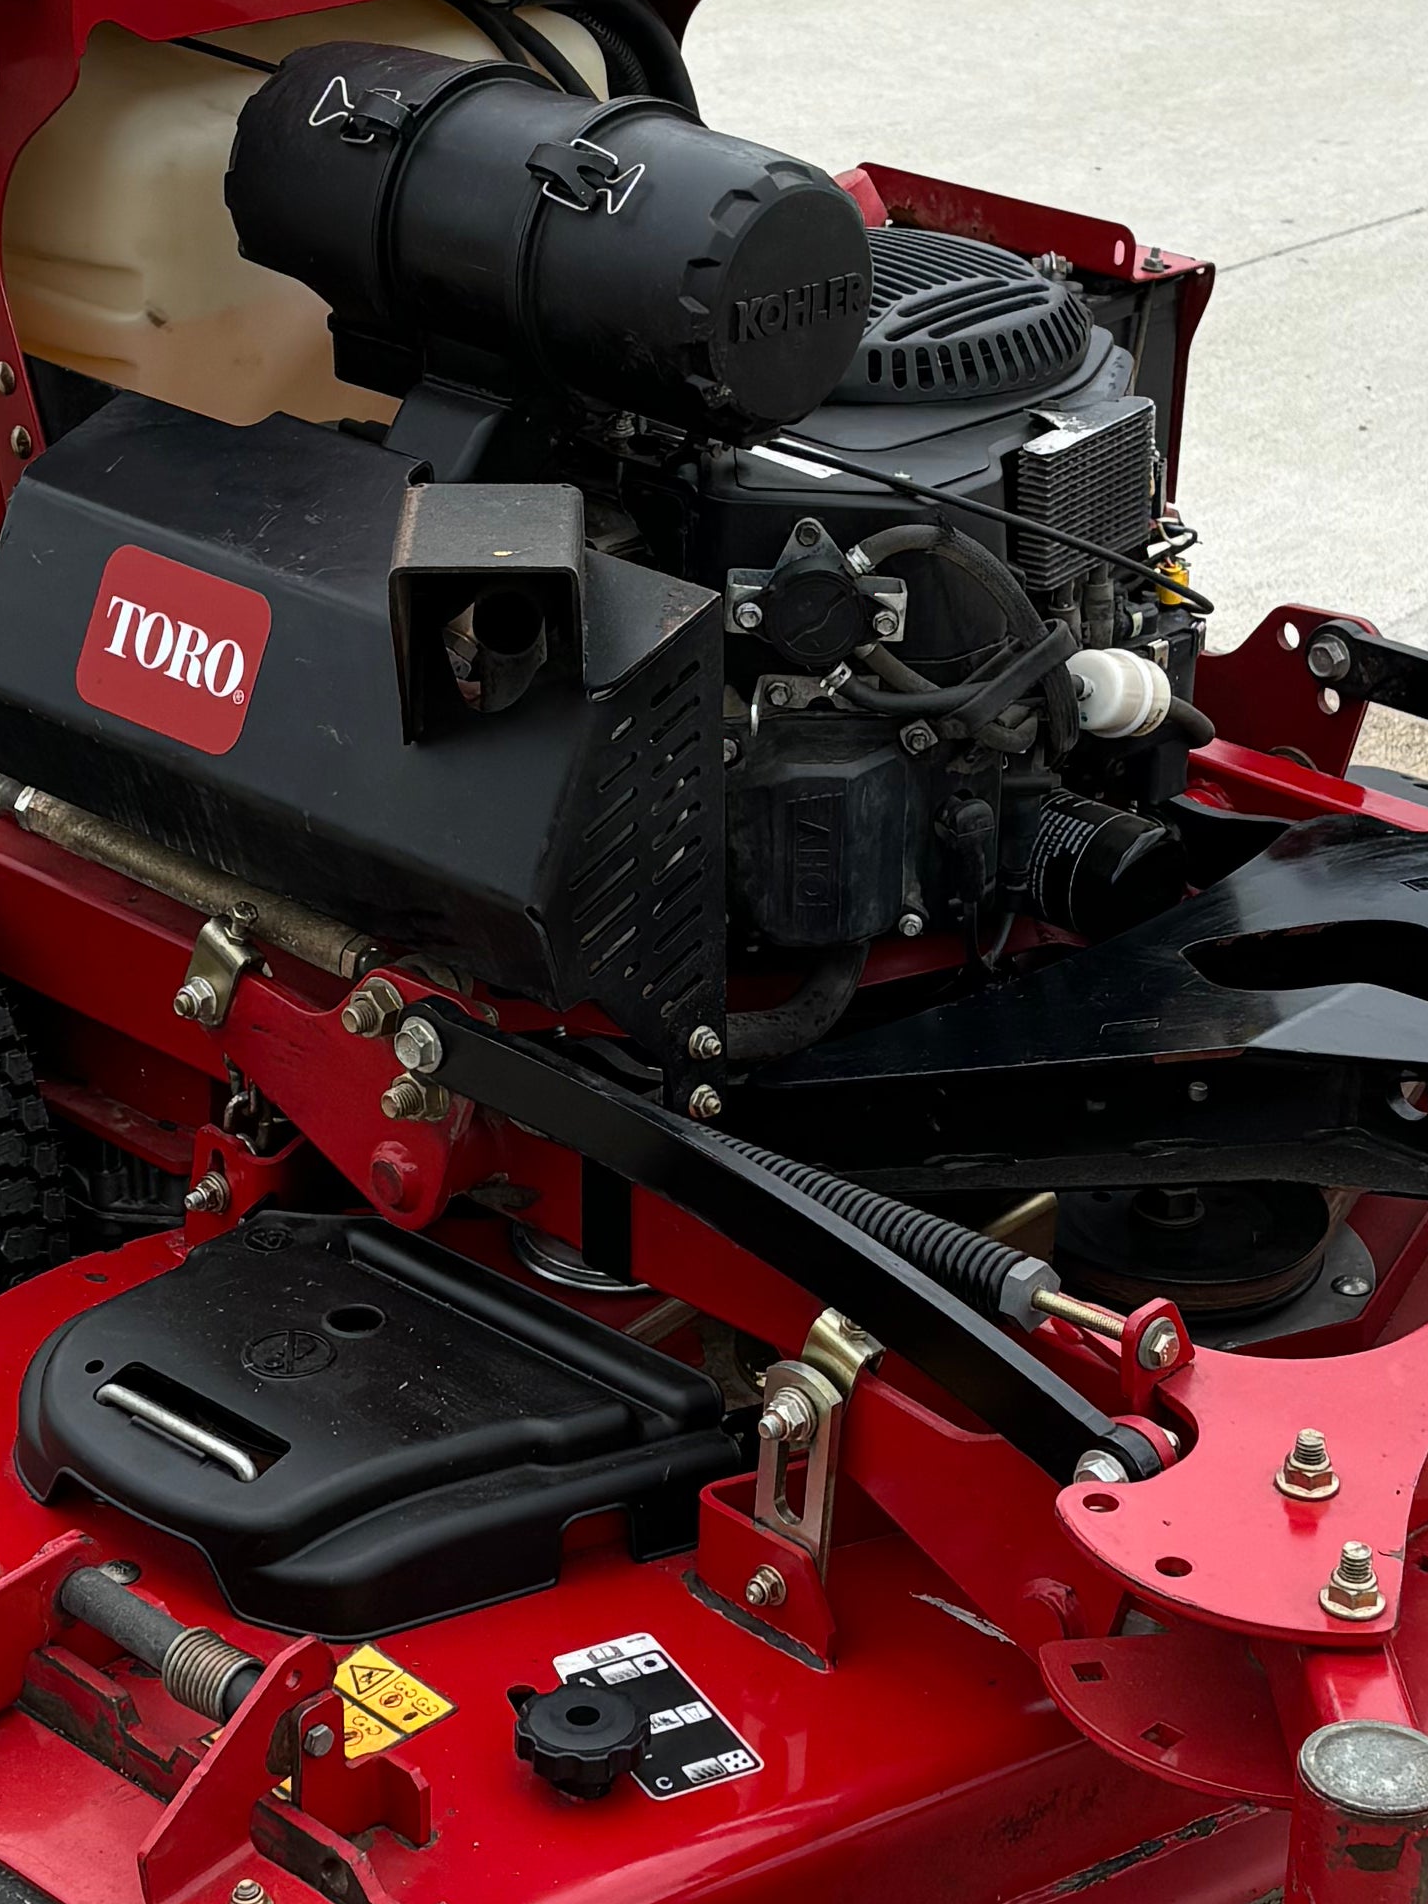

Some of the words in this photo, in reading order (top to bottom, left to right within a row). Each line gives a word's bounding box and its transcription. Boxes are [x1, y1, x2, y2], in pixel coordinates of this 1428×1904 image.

[734, 272, 866, 343] KOHLER
[104, 595, 245, 698] TORO
[655, 1776, 673, 1790] C
